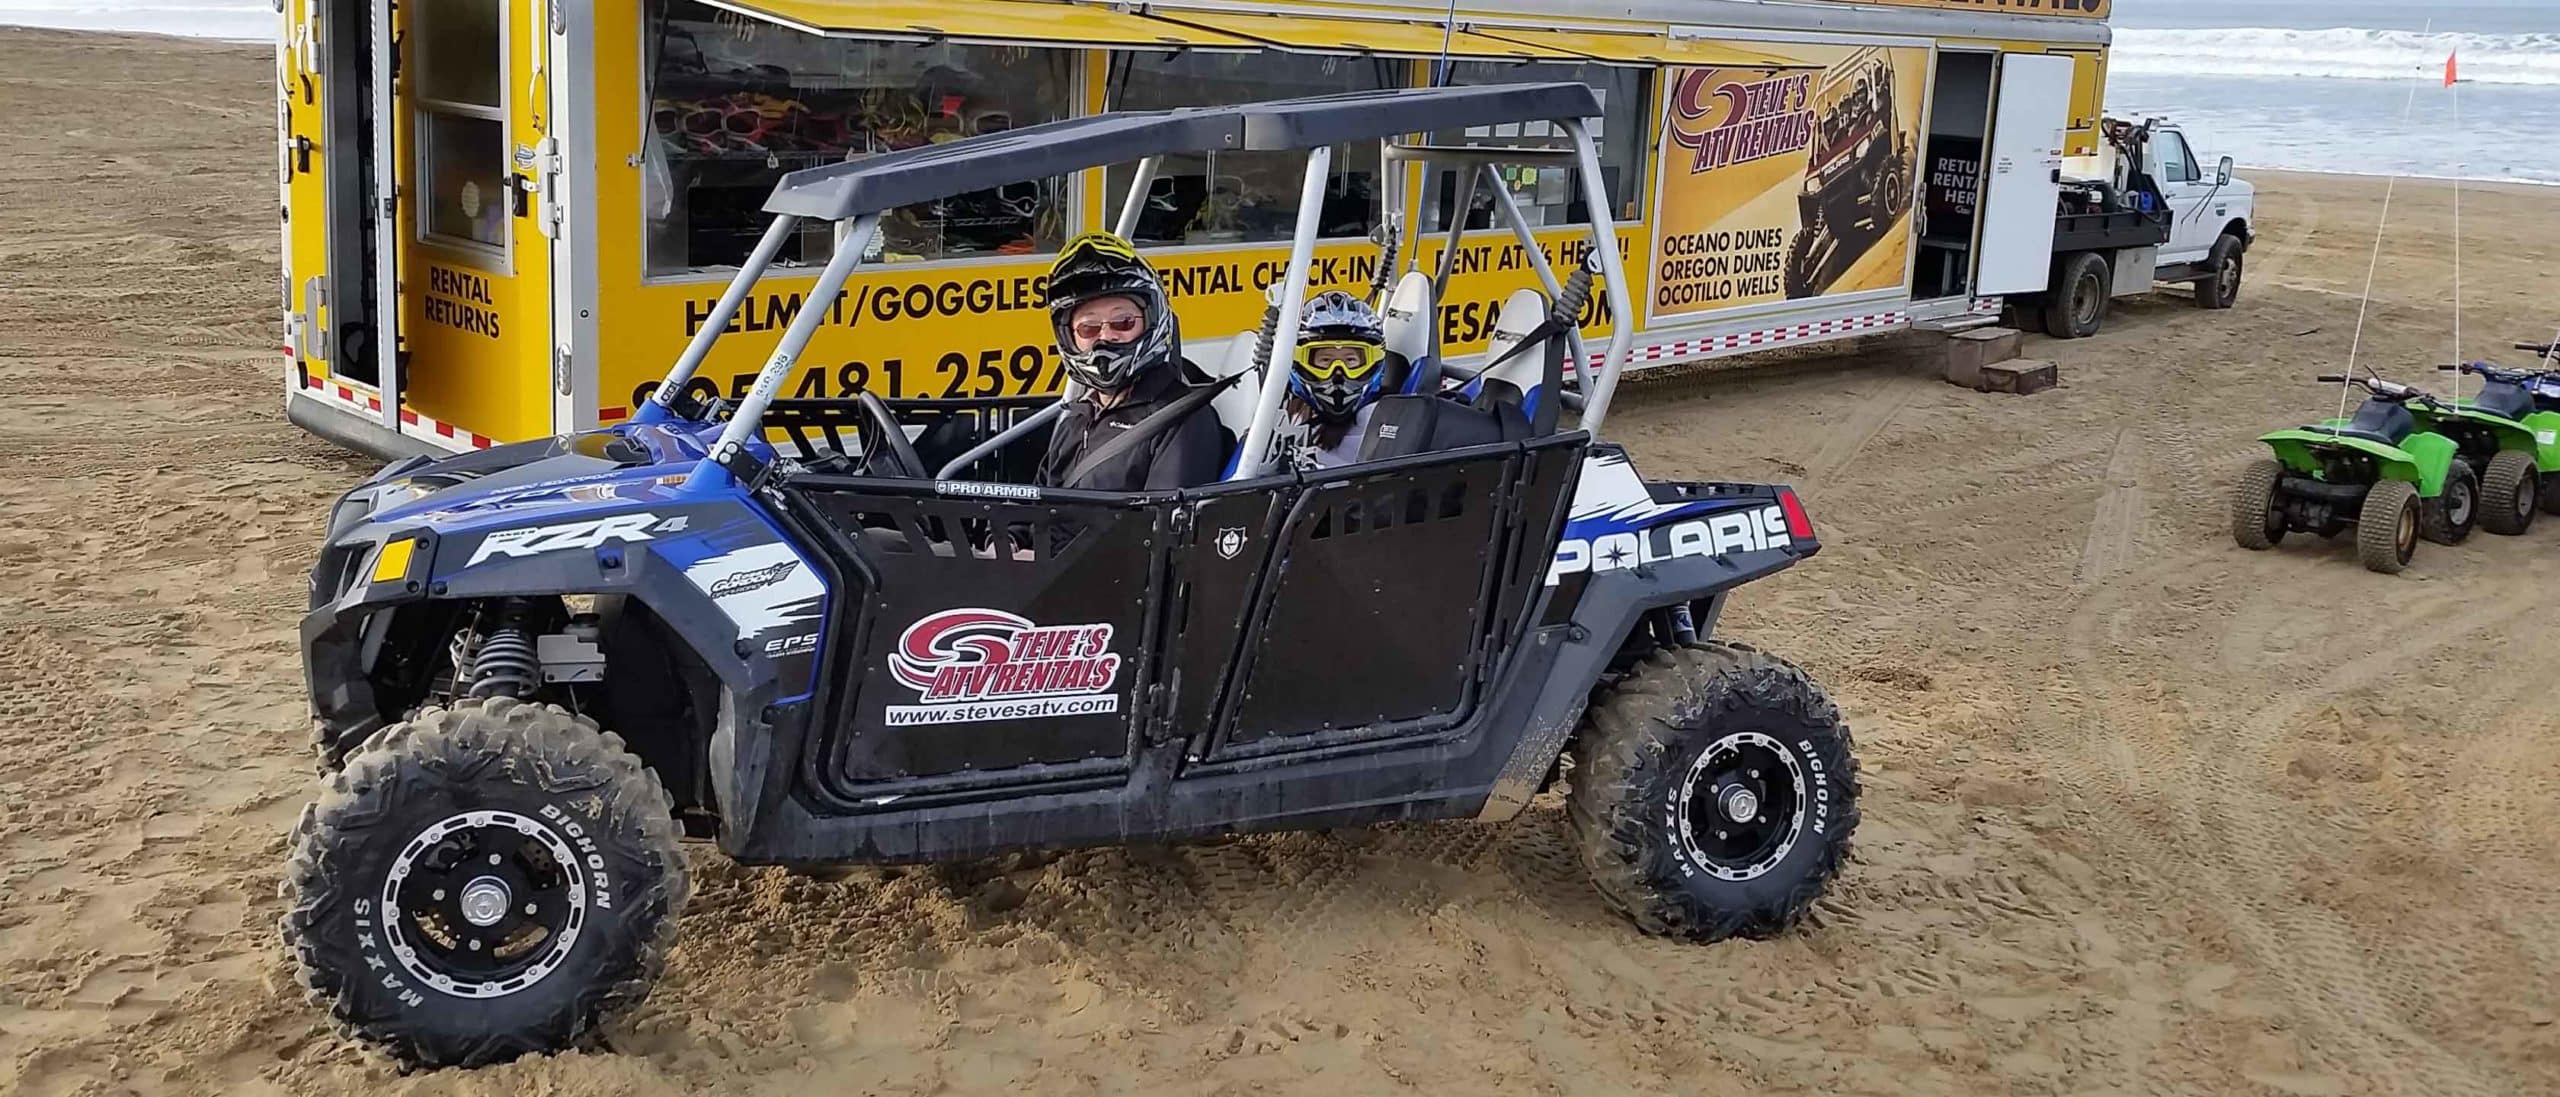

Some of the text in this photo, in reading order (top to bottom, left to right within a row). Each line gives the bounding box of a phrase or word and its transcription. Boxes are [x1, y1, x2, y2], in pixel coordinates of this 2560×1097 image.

[1691, 109, 1816, 175] ATV RENTALS
[1937, 157, 1979, 175] RETU
[1944, 189, 1977, 206] HER
[1664, 227, 1783, 257] OCEANO DUNES
[430, 265, 493, 306] RENTAL
[1156, 254, 1377, 298] ENTAL CHCK-IN
[1661, 251, 1781, 282] OREGON DUNES
[1658, 274, 1779, 307] OCOTILLO WELLS
[424, 294, 500, 339] RETURNS
[949, 482, 1038, 499] PRO ARMOR
[464, 512, 689, 569] RZR 4
[1544, 504, 1792, 587] POLARIS
[764, 632, 819, 652] EPS
[926, 656, 1117, 699] ATV RENTALS
[888, 700, 1115, 724] www.stevesatv.com
[1797, 738, 1829, 835] BIGHORN
[1664, 786, 1695, 879] MAXXIS
[538, 802, 612, 911] BIGHORN
[352, 897, 424, 1009] MAXXIS
